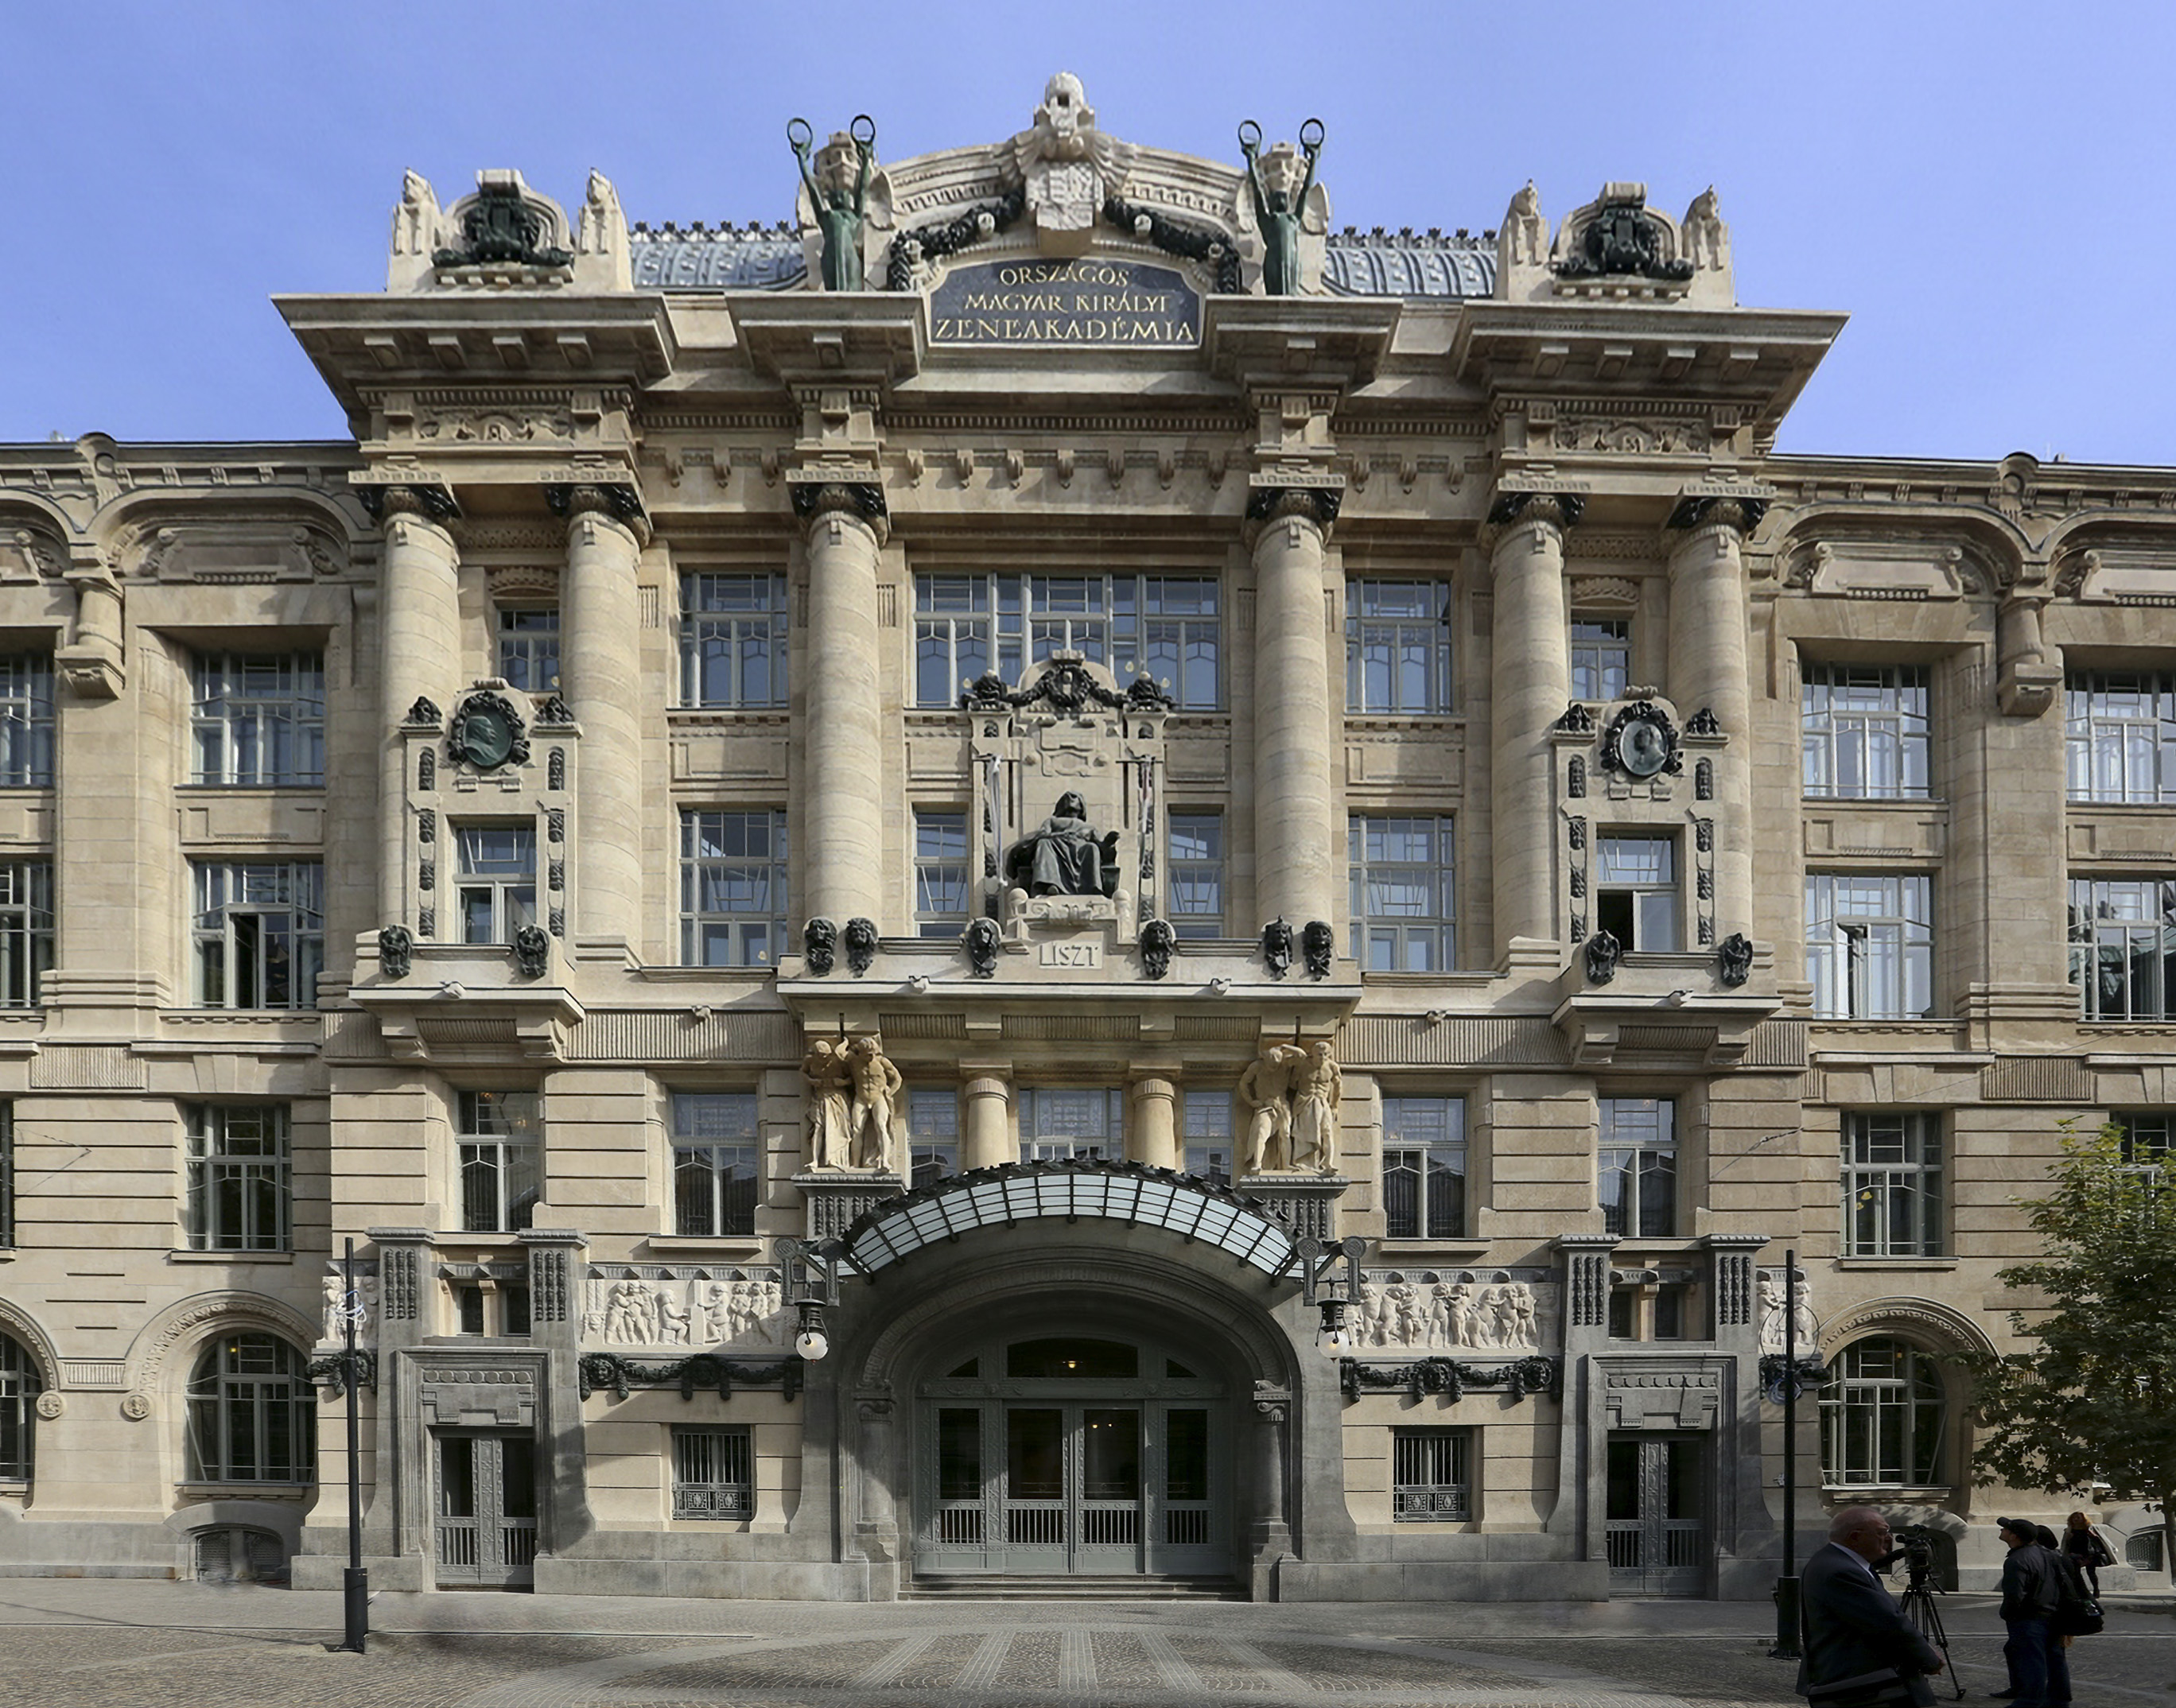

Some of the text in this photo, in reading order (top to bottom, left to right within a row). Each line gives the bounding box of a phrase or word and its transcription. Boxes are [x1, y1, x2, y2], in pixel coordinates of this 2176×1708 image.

[1000, 262, 1129, 287] ORSZÁGOS
[964, 291, 1172, 313] MAGYAR KIRÁLYI
[935, 316, 1195, 341] ZENEAKADÉMIA
[1039, 944, 1098, 966] LISZT
